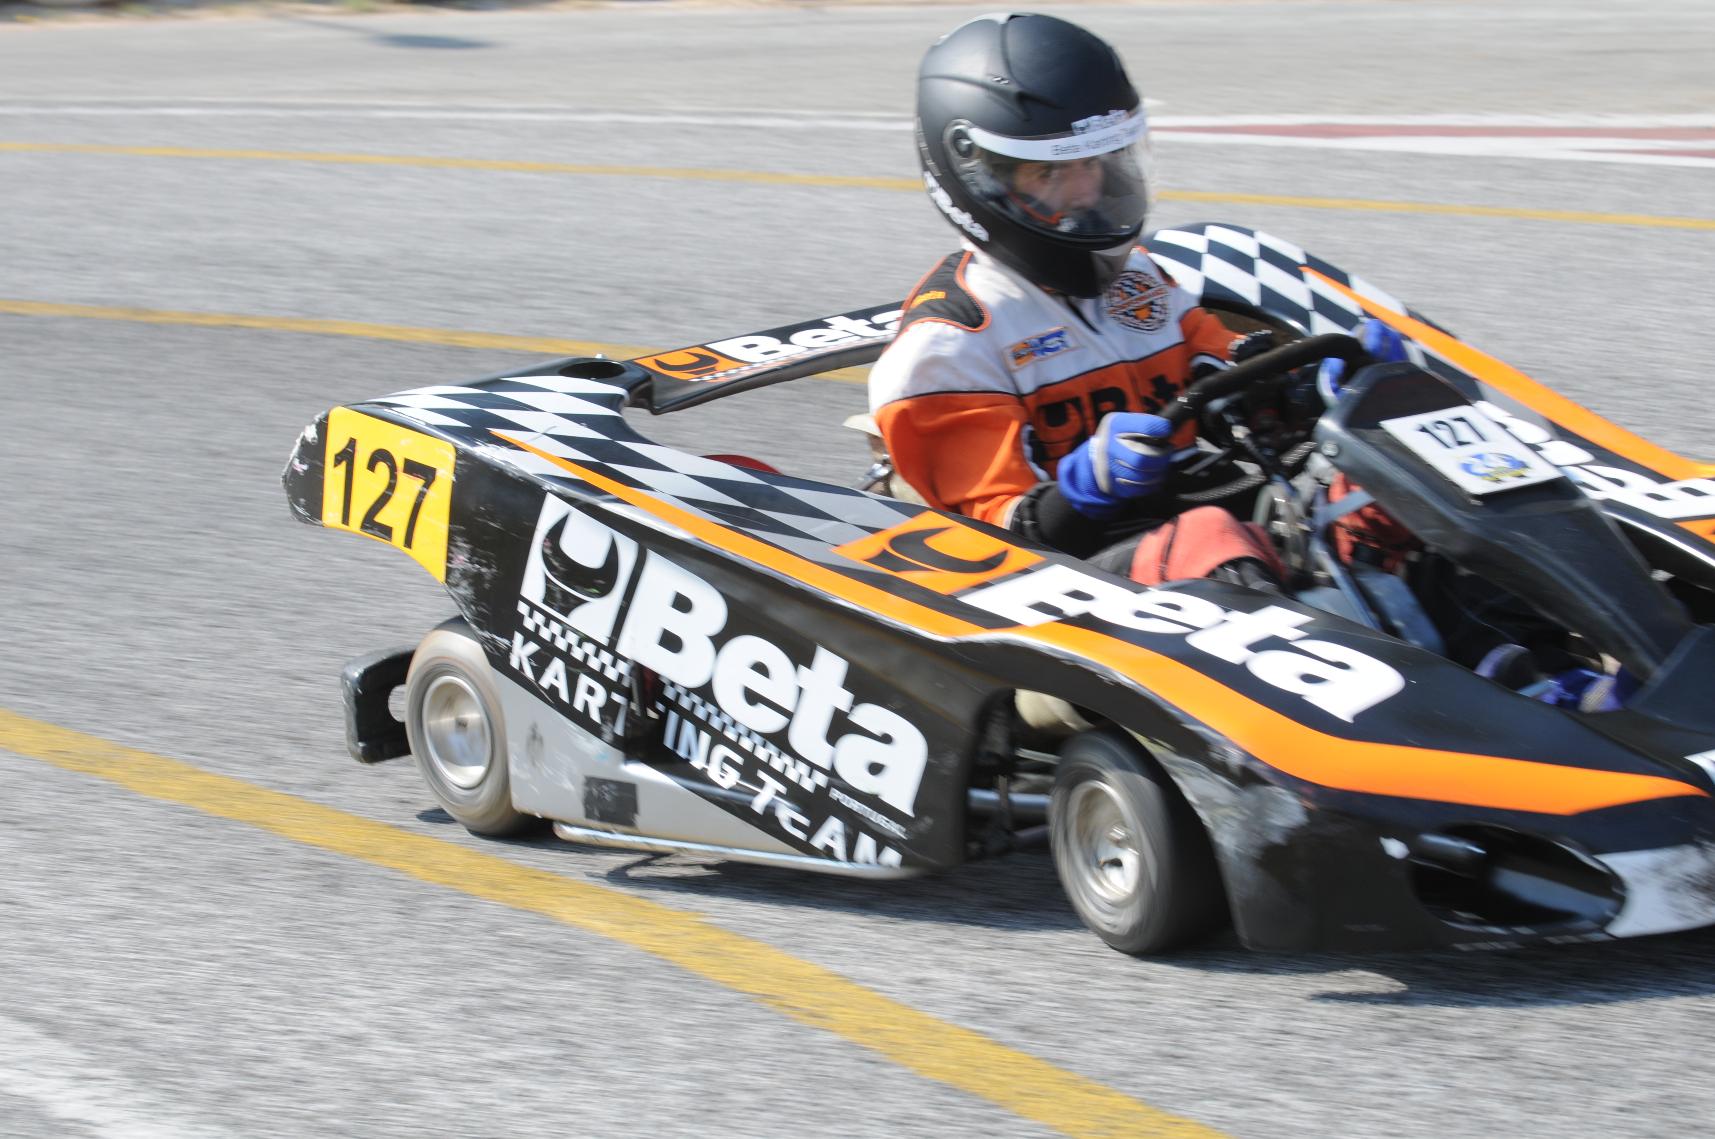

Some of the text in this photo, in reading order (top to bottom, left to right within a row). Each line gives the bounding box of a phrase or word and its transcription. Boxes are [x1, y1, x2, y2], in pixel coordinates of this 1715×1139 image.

[333, 436, 437, 550] 127
[1417, 416, 1487, 449] 127
[615, 548, 928, 818] Beta
[957, 564, 1406, 724] Beta
